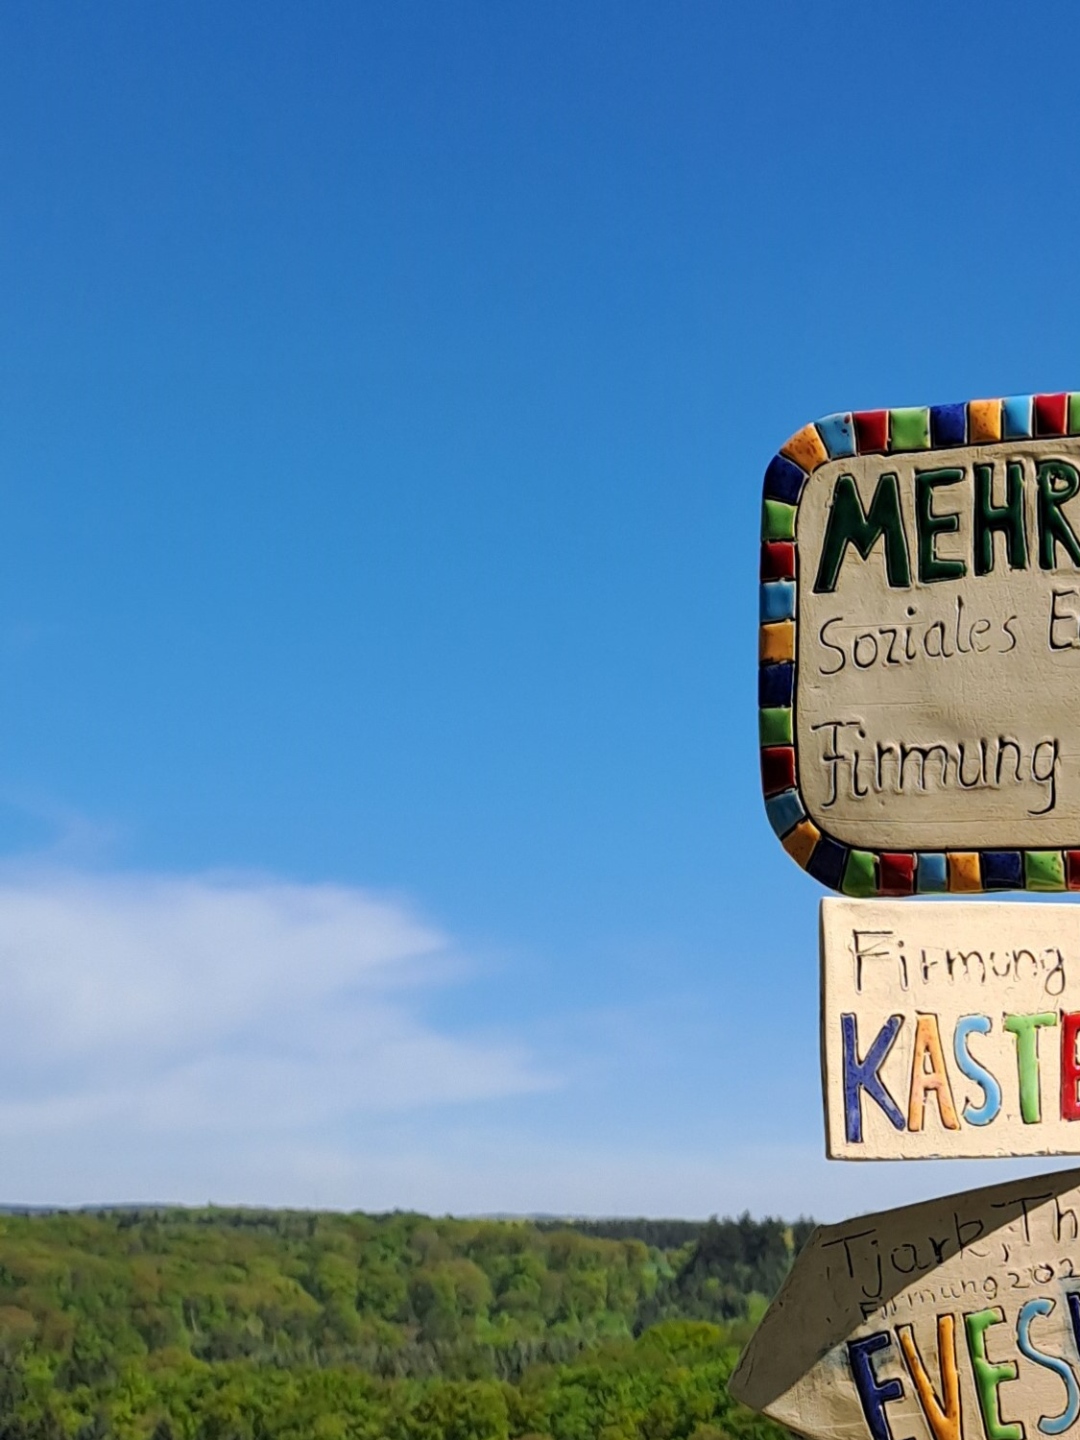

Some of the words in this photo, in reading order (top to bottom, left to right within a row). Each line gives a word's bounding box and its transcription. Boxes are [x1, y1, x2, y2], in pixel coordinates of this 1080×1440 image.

[817, 594, 1017, 676] Soziales
[811, 718, 1061, 814] Firmung
[850, 929, 1066, 995] Firmung
[859, 1275, 998, 1321] Firmung
